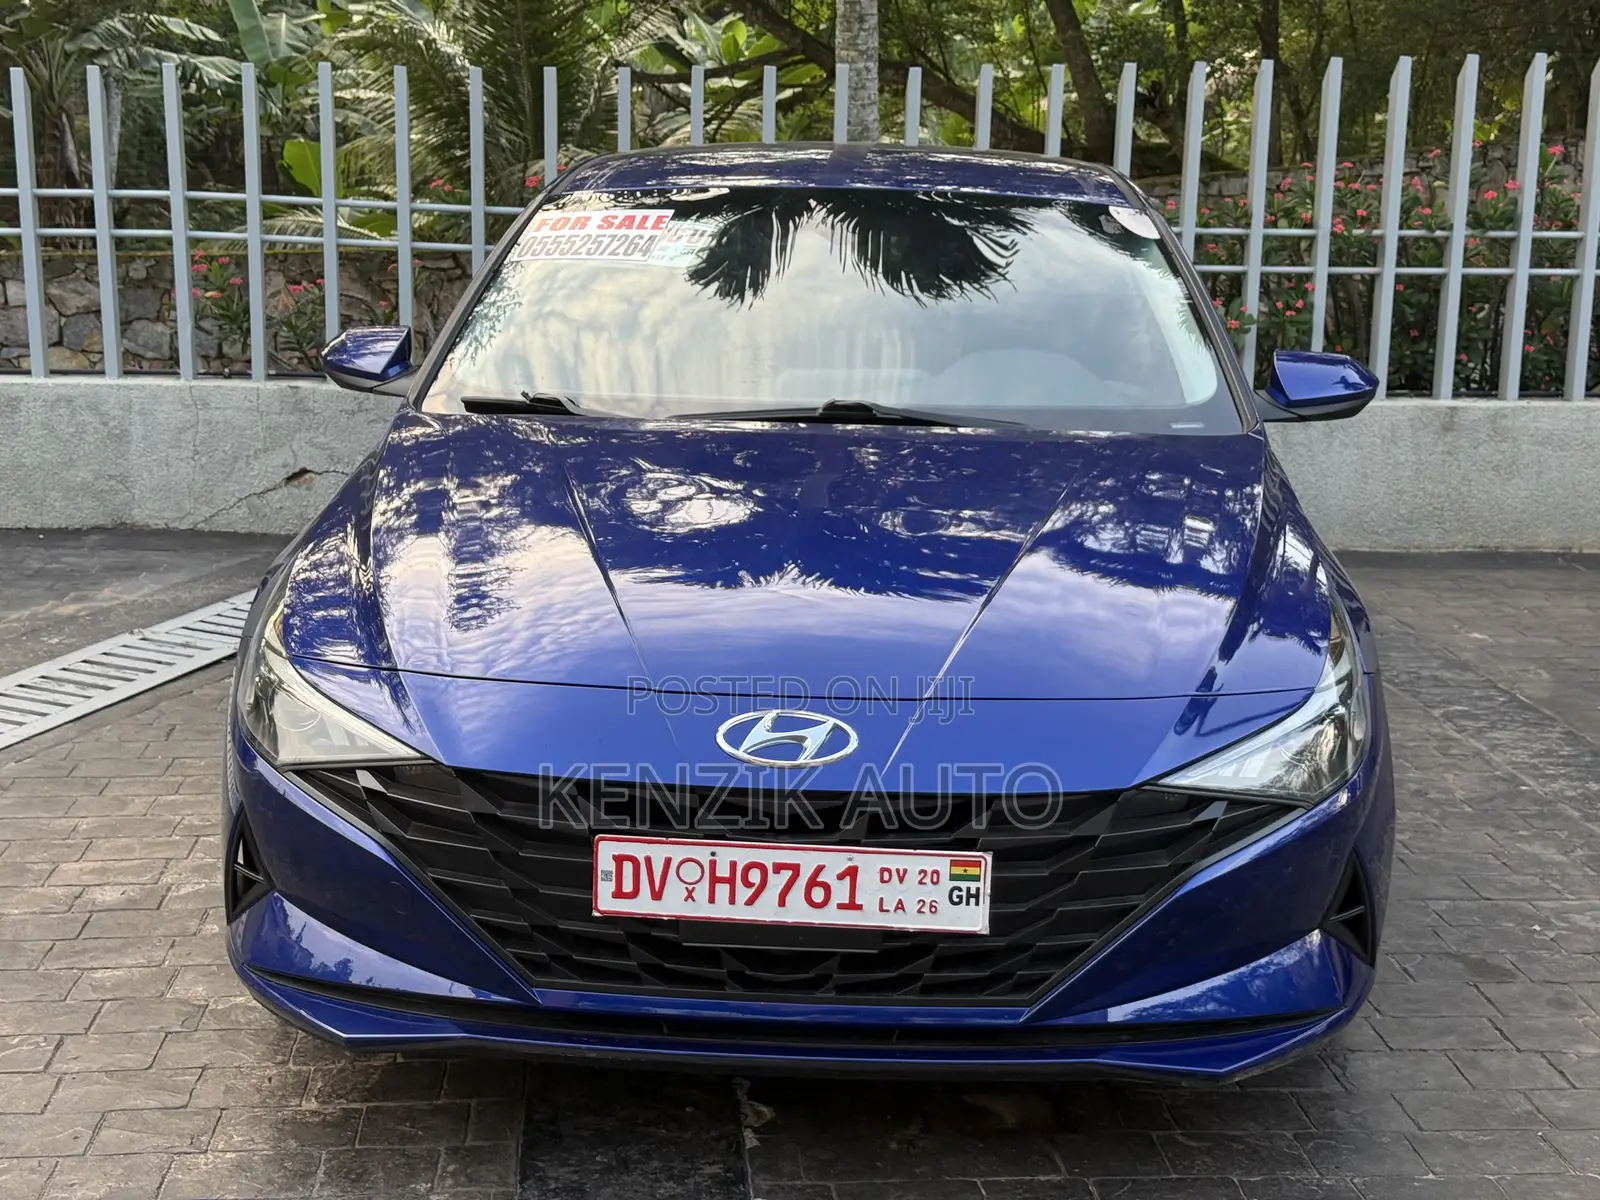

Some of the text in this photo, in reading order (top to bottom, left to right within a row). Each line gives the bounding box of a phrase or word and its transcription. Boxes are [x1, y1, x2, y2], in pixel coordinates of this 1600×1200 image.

[533, 215, 670, 232] FOR SALE
[517, 234, 658, 258] 0555257264
[611, 853, 673, 902] DV
[707, 858, 863, 910] H9761
[879, 867, 941, 886] DV 20
[878, 896, 940, 915] LA 26
[948, 885, 981, 906] GH
